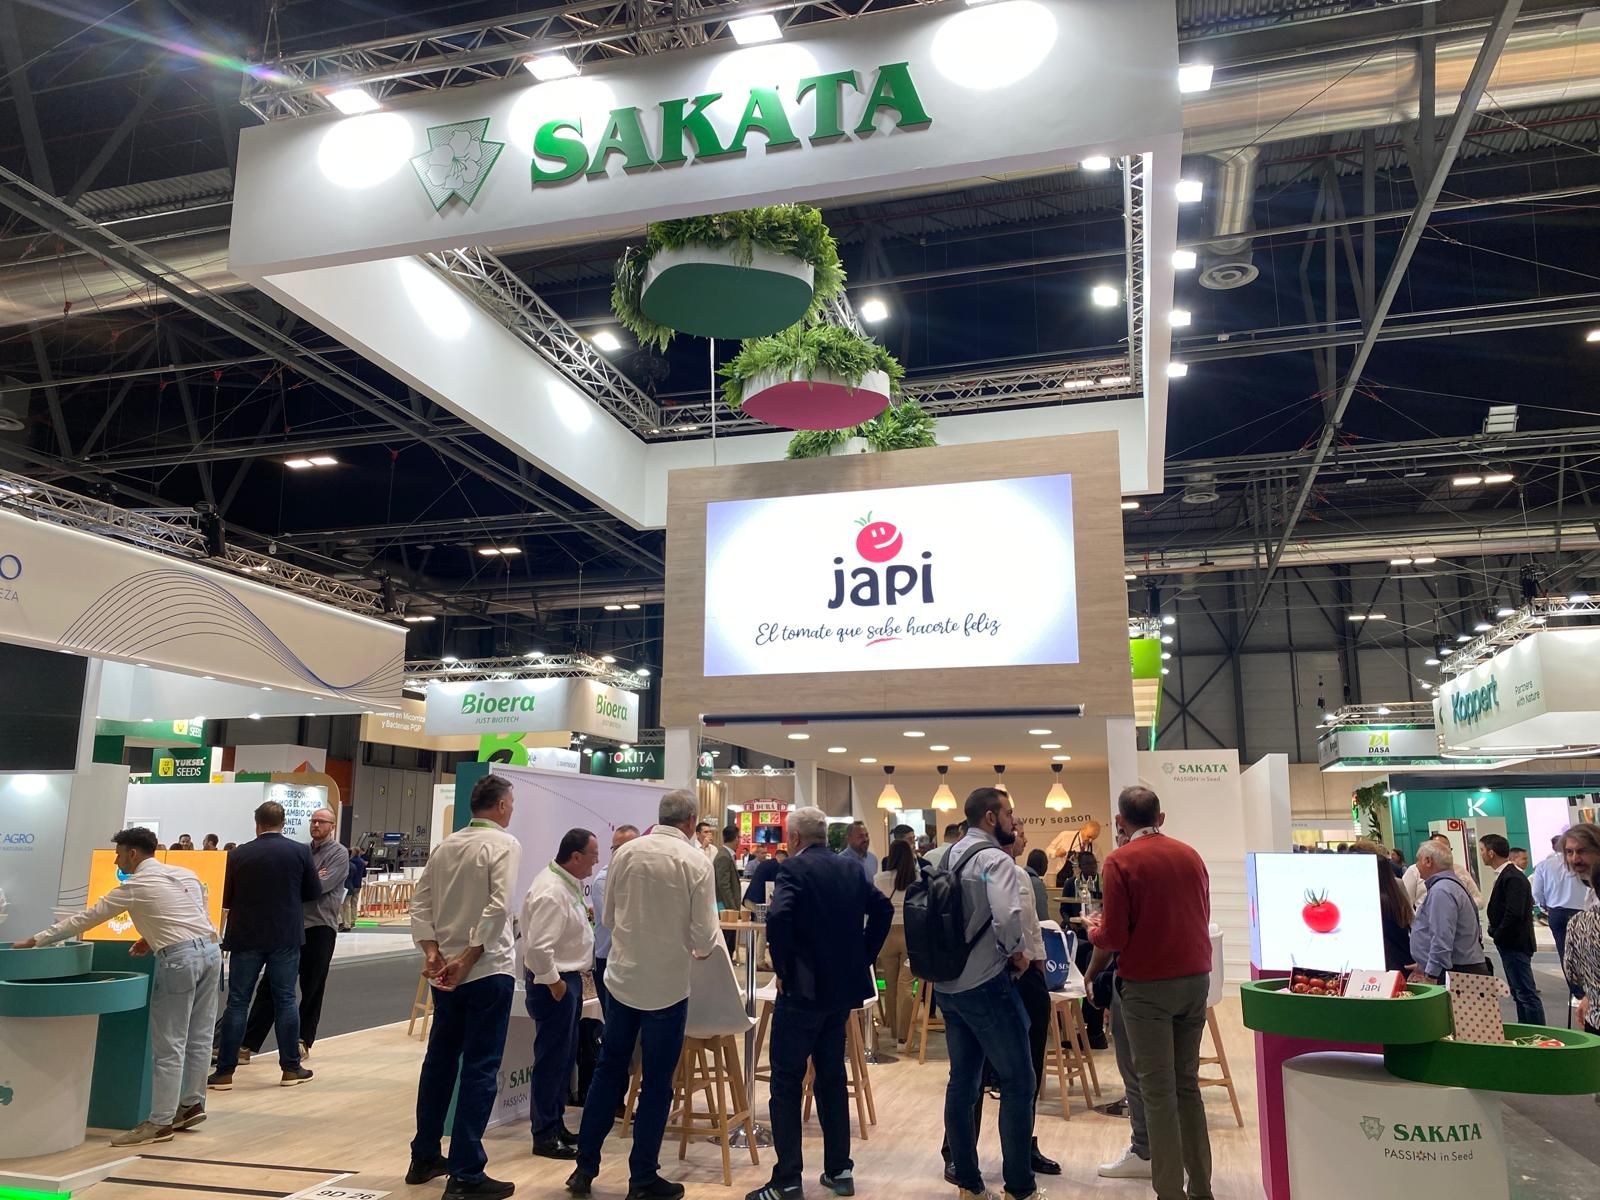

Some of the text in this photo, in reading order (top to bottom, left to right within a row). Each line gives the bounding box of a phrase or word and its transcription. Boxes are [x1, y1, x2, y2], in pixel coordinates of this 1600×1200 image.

[530, 61, 933, 190] SAKATA
[827, 551, 934, 609] japi
[755, 612, 1002, 646] El tomate que sabe hacerte feliz
[461, 692, 536, 715] Bioera
[1451, 674, 1500, 726] Koppert
[596, 693, 628, 721] Bioera
[475, 716, 519, 725] JUST BIOTECH
[1368, 746, 1391, 754] DASA
[608, 751, 656, 764] TOKITA
[176, 766, 202, 777] SEEDS
[1178, 764, 1229, 773] SAKATA
[1018, 814, 1091, 827] very season
[3, 833, 35, 844] AGRO
[1393, 1122, 1483, 1143] SAKATA
[1440, 1150, 1449, 1161] in
[1451, 1150, 1474, 1161] Seed
